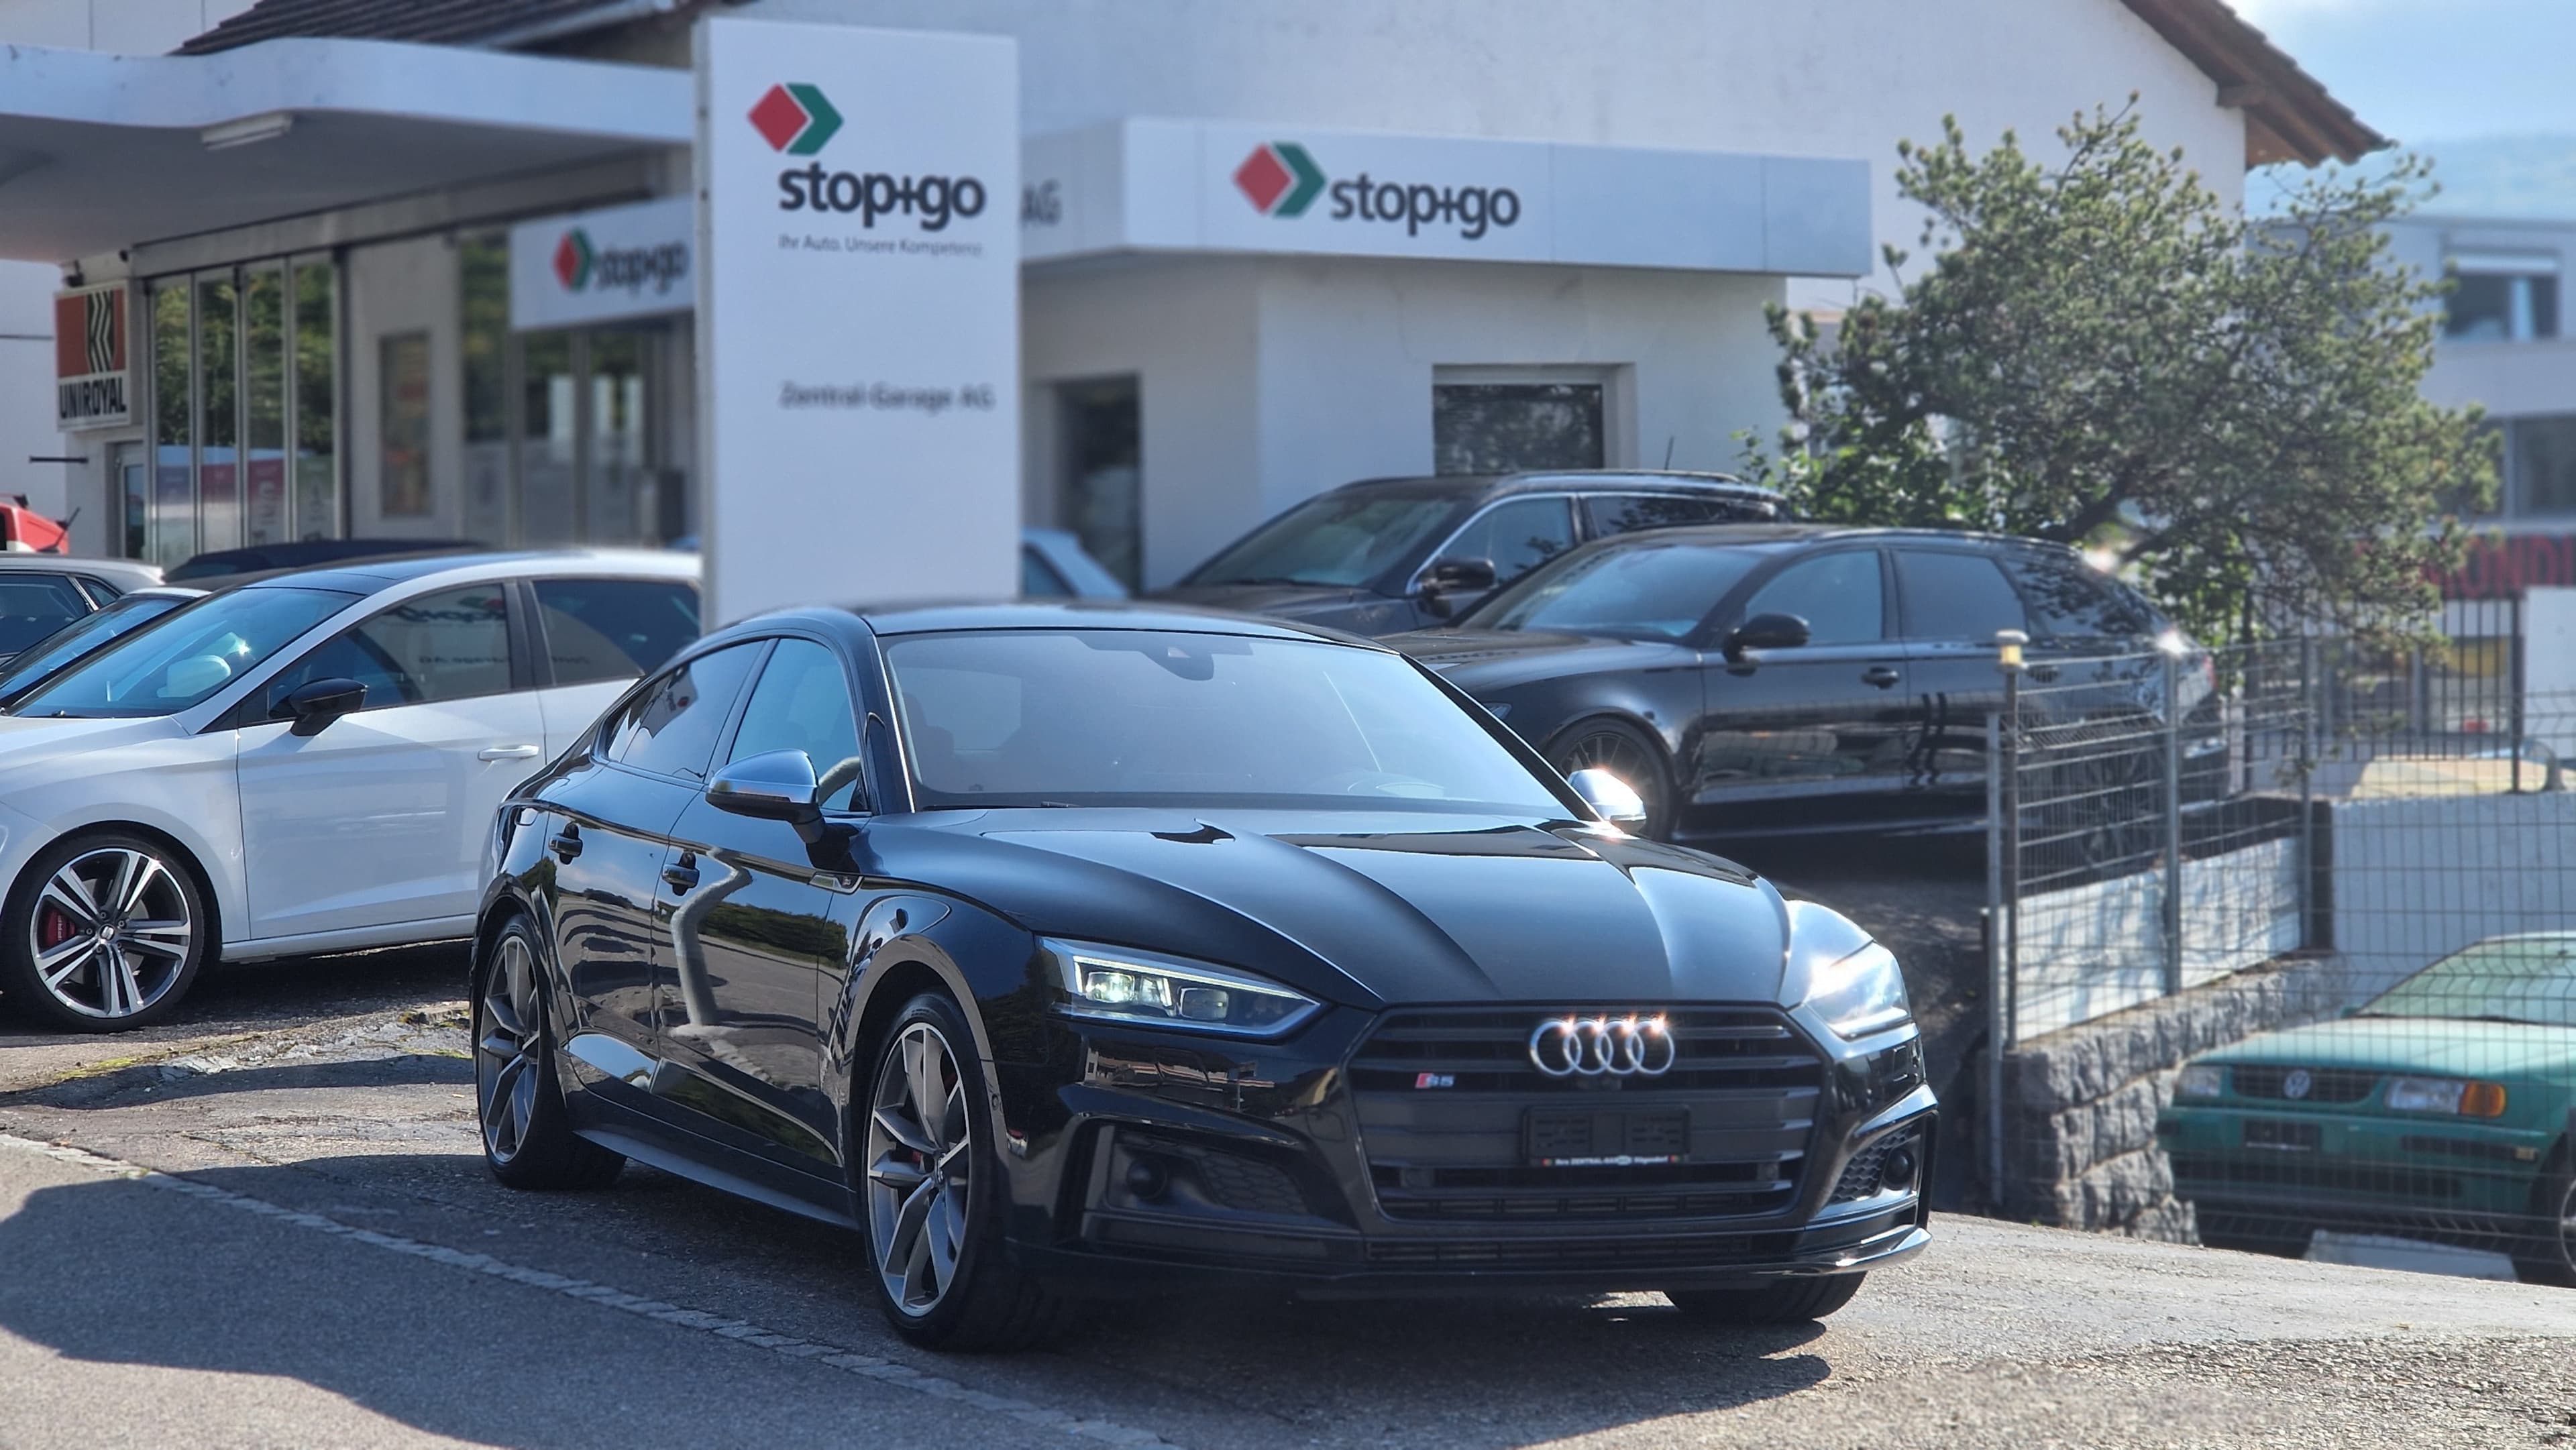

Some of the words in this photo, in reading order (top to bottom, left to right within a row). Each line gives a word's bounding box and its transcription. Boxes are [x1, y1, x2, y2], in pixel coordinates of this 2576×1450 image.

[778, 162, 986, 231] stop+go
[1330, 172, 1521, 241] stop+go
[593, 241, 689, 297] stop+go
[59, 377, 126, 419] UNIROYAL
[959, 383, 996, 411] AG
